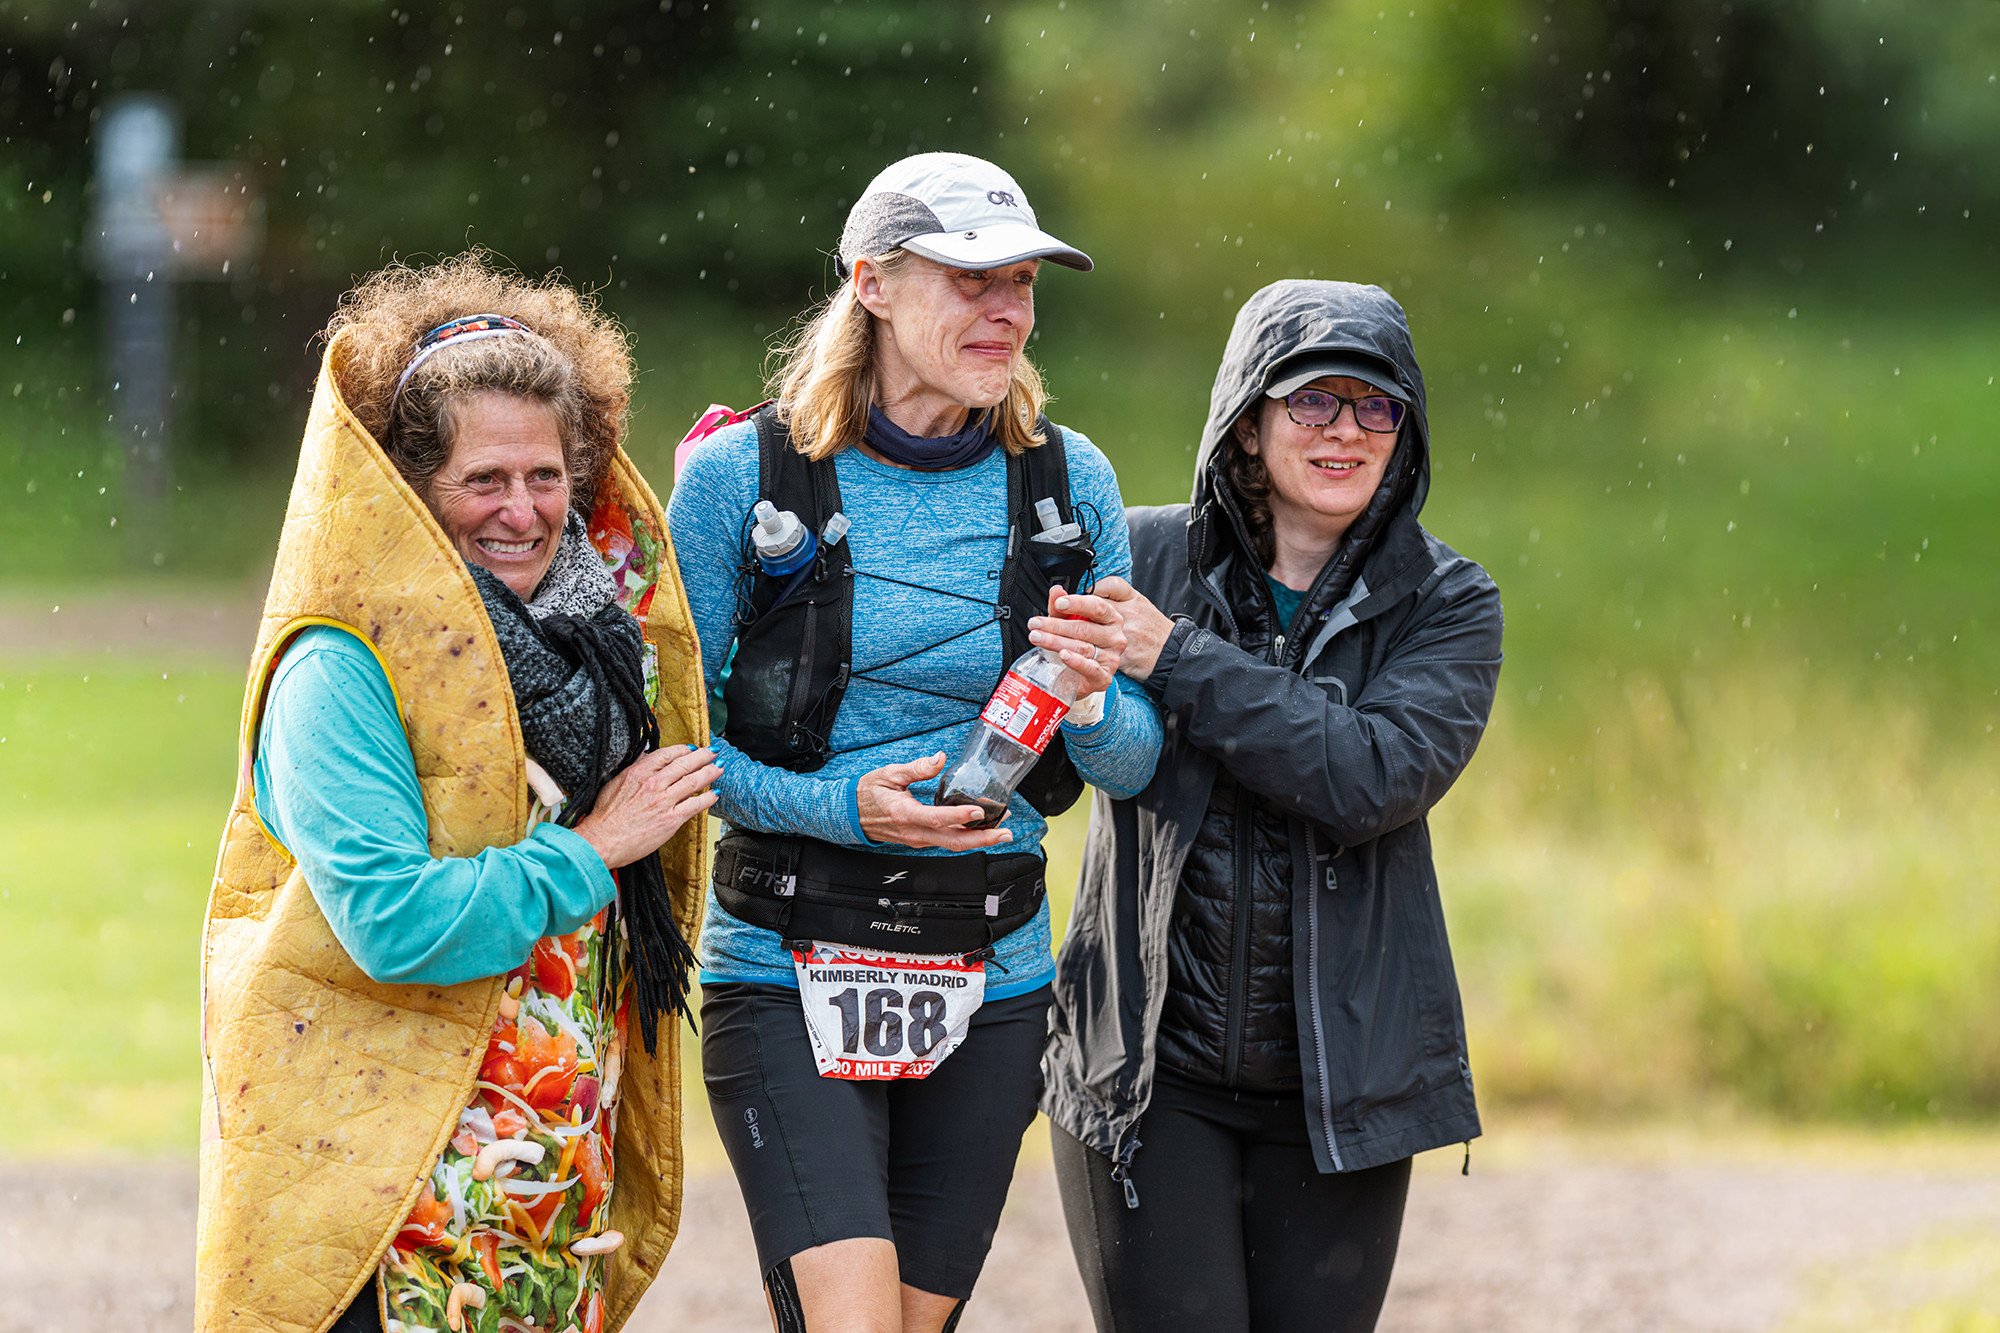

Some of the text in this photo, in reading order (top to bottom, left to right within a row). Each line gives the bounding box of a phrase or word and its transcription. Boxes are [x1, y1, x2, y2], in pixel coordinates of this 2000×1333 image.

[986, 190, 1018, 207] OR
[1033, 717, 1054, 749] RECYCLE
[1052, 706, 1063, 718] ME
[809, 969, 968, 989] KIMBERLY MADRID
[828, 987, 948, 1058] 168
[832, 1060, 934, 1077] 00 MILE 202
[748, 1122, 764, 1149] janji
